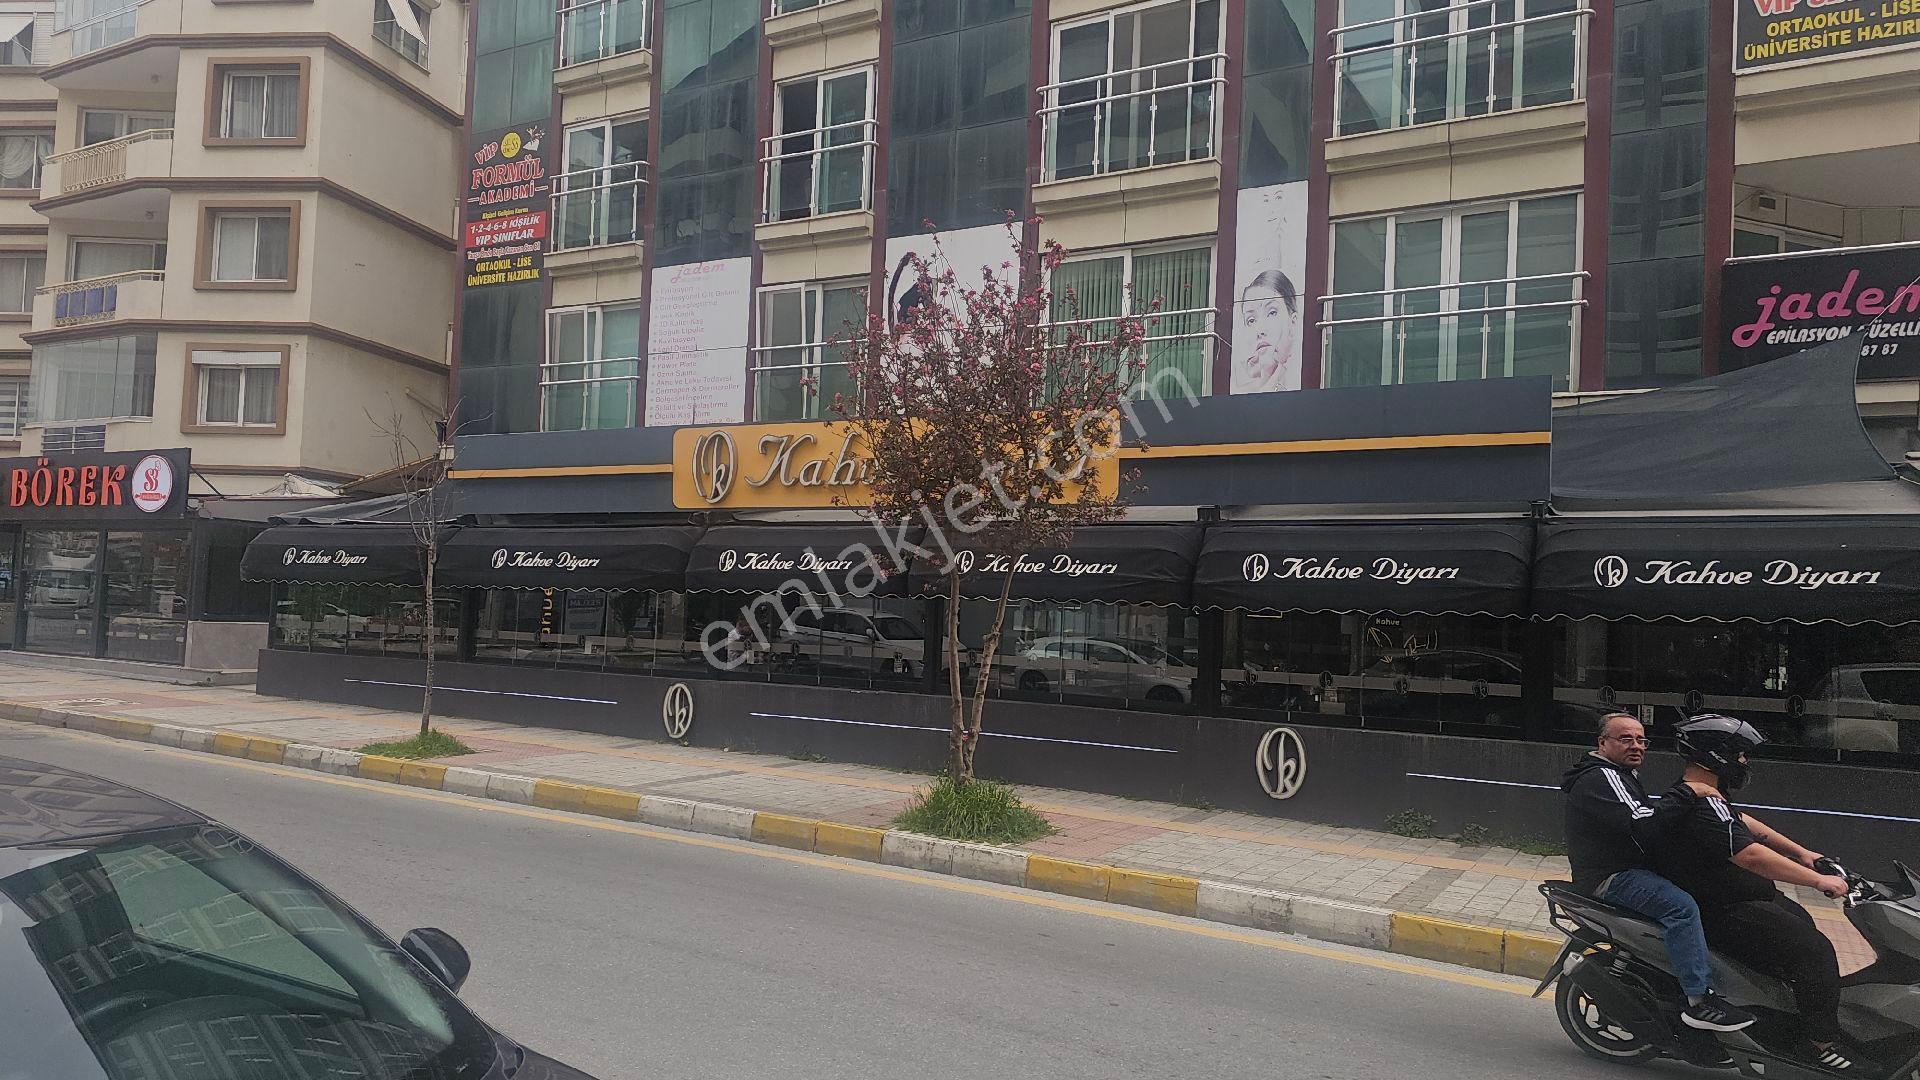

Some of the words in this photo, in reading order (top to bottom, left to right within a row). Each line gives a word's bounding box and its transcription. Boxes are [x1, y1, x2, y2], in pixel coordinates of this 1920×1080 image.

[1766, 8, 1865, 36] ORTAOKUL
[1881, 0, 1920, 18] LİSE
[1744, 29, 1852, 61] ÜNİVERSİTE
[1857, 19, 1920, 42] HAZIR
[474, 141, 498, 165] VİP
[471, 154, 544, 190] FORMÜL
[479, 180, 535, 205] AKADEMİ
[509, 214, 540, 229] KİŞİLİK
[492, 229, 534, 243] SINIFLAR
[476, 259, 512, 273] ORTAOKUL
[517, 255, 532, 268] LİSE
[670, 262, 725, 284] jadem
[467, 271, 506, 287] ÜNİVERSİTE
[507, 268, 540, 282] HAZIRLIK
[1766, 325, 1852, 345] EPİLASYON
[1859, 318, 1920, 338] ÜZELLİ
[1861, 344, 1878, 356] 87
[1881, 343, 1898, 355] 87
[744, 432, 892, 487] Kahv
[10, 458, 126, 507] BÖREK
[295, 549, 331, 565] Kahve
[333, 550, 368, 567] Diyarı
[508, 552, 553, 568] Kahve
[554, 552, 601, 571] Diyarı
[738, 552, 795, 570] Kahve
[797, 552, 852, 574] Diyarı
[1049, 554, 1118, 577] Diyarı
[1273, 557, 1363, 580] Kahve
[1369, 557, 1460, 585] Diyarı
[1635, 560, 1753, 585] Kahve
[1762, 560, 1881, 589] Diyarı
